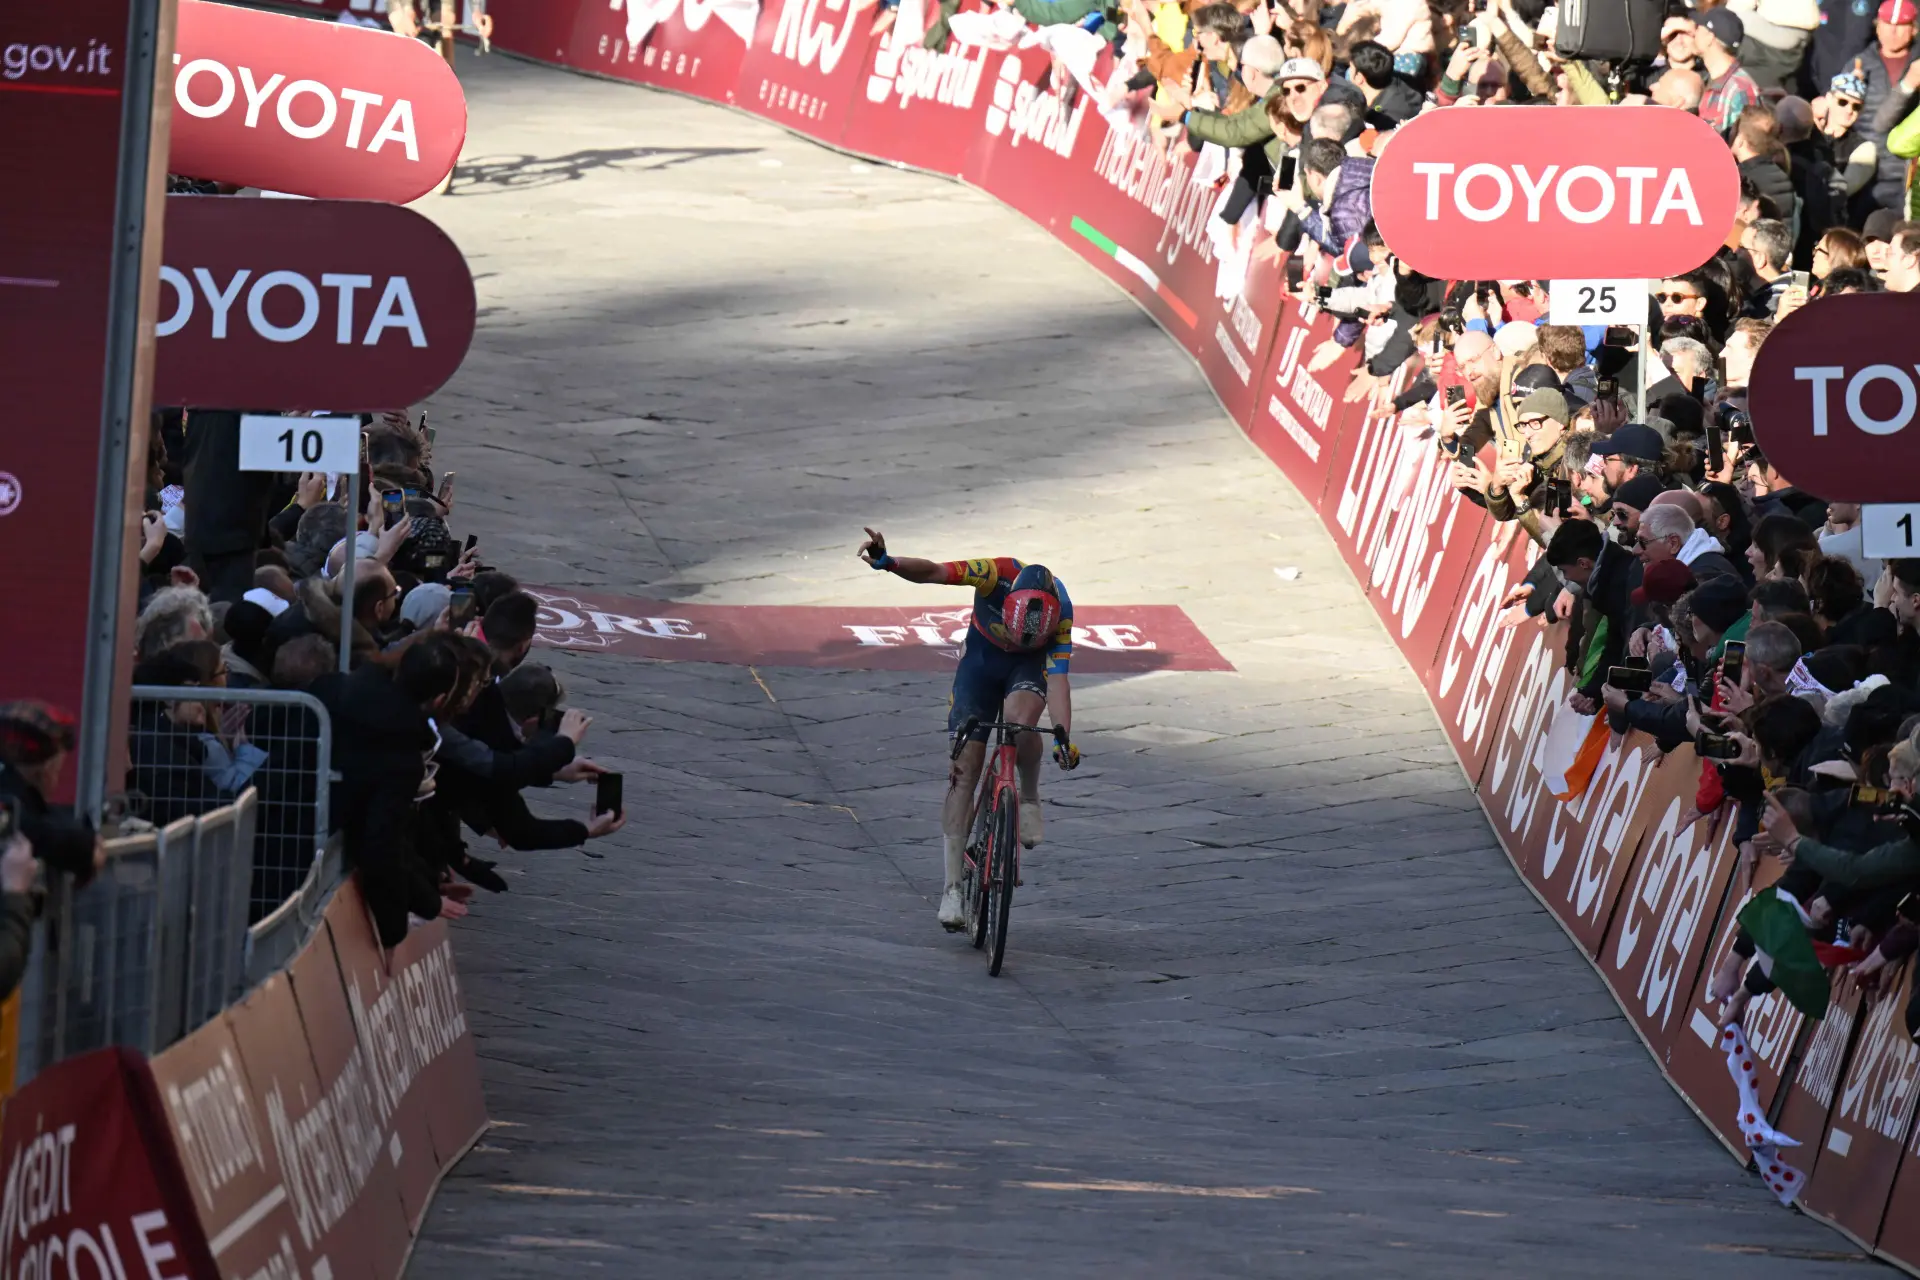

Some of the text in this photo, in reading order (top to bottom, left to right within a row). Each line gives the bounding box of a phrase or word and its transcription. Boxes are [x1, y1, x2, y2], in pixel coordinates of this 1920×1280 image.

[3, 38, 111, 79] gov.it
[597, 34, 702, 78] eyewear
[171, 53, 420, 162] OYOTA
[758, 78, 828, 121] eyewear
[1413, 162, 1704, 225] TOYOTA
[1578, 286, 1617, 314] 25
[1794, 363, 1920, 436] TO
[277, 430, 324, 463] 10
[1616, 796, 1737, 1033] enel
